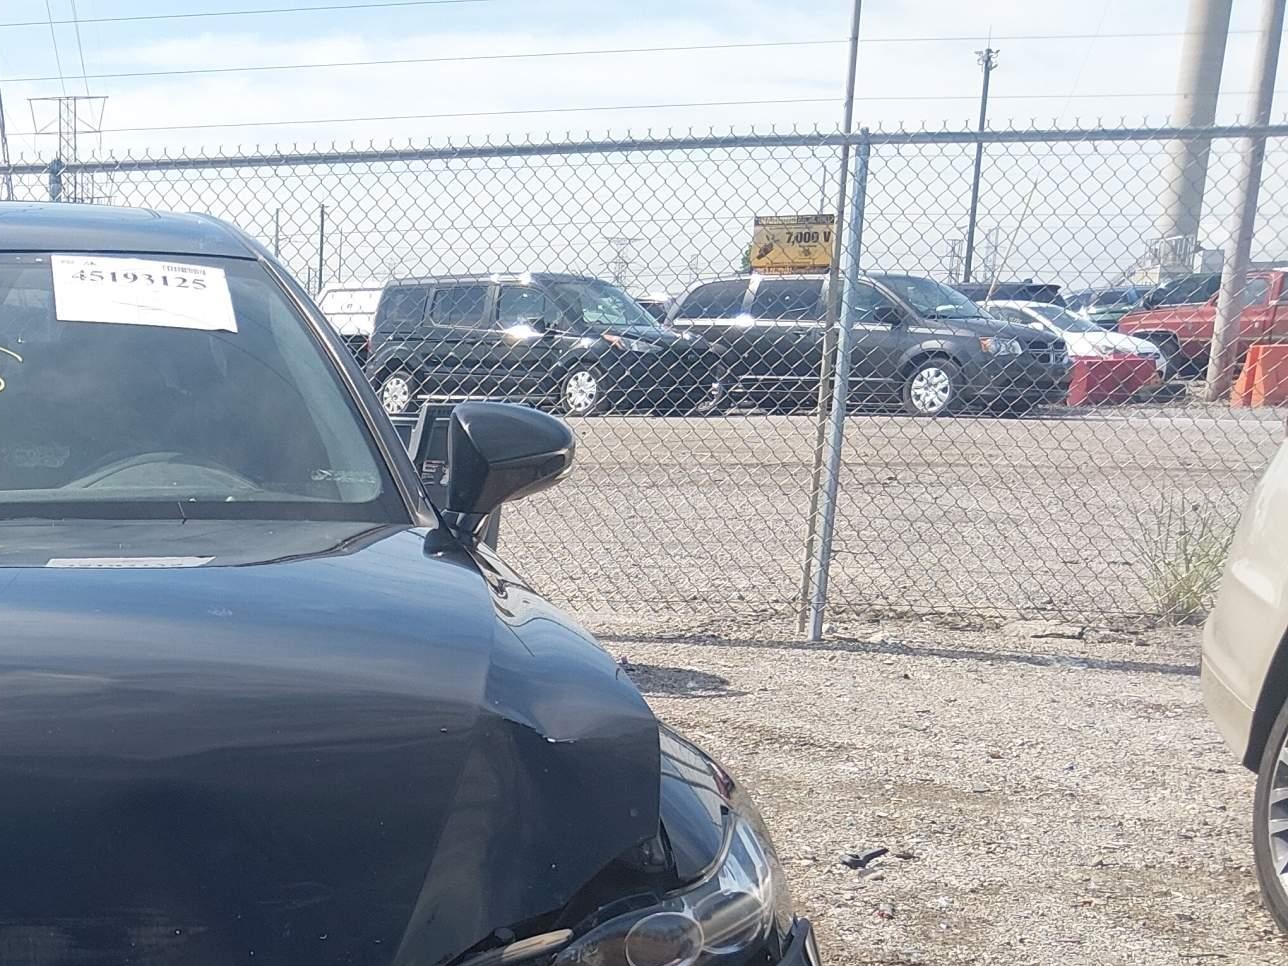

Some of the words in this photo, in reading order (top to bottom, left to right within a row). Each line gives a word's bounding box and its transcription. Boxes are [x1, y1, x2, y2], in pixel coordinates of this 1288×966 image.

[786, 231, 819, 247] 7,000
[823, 231, 831, 243] V
[72, 269, 207, 290] 45193125
